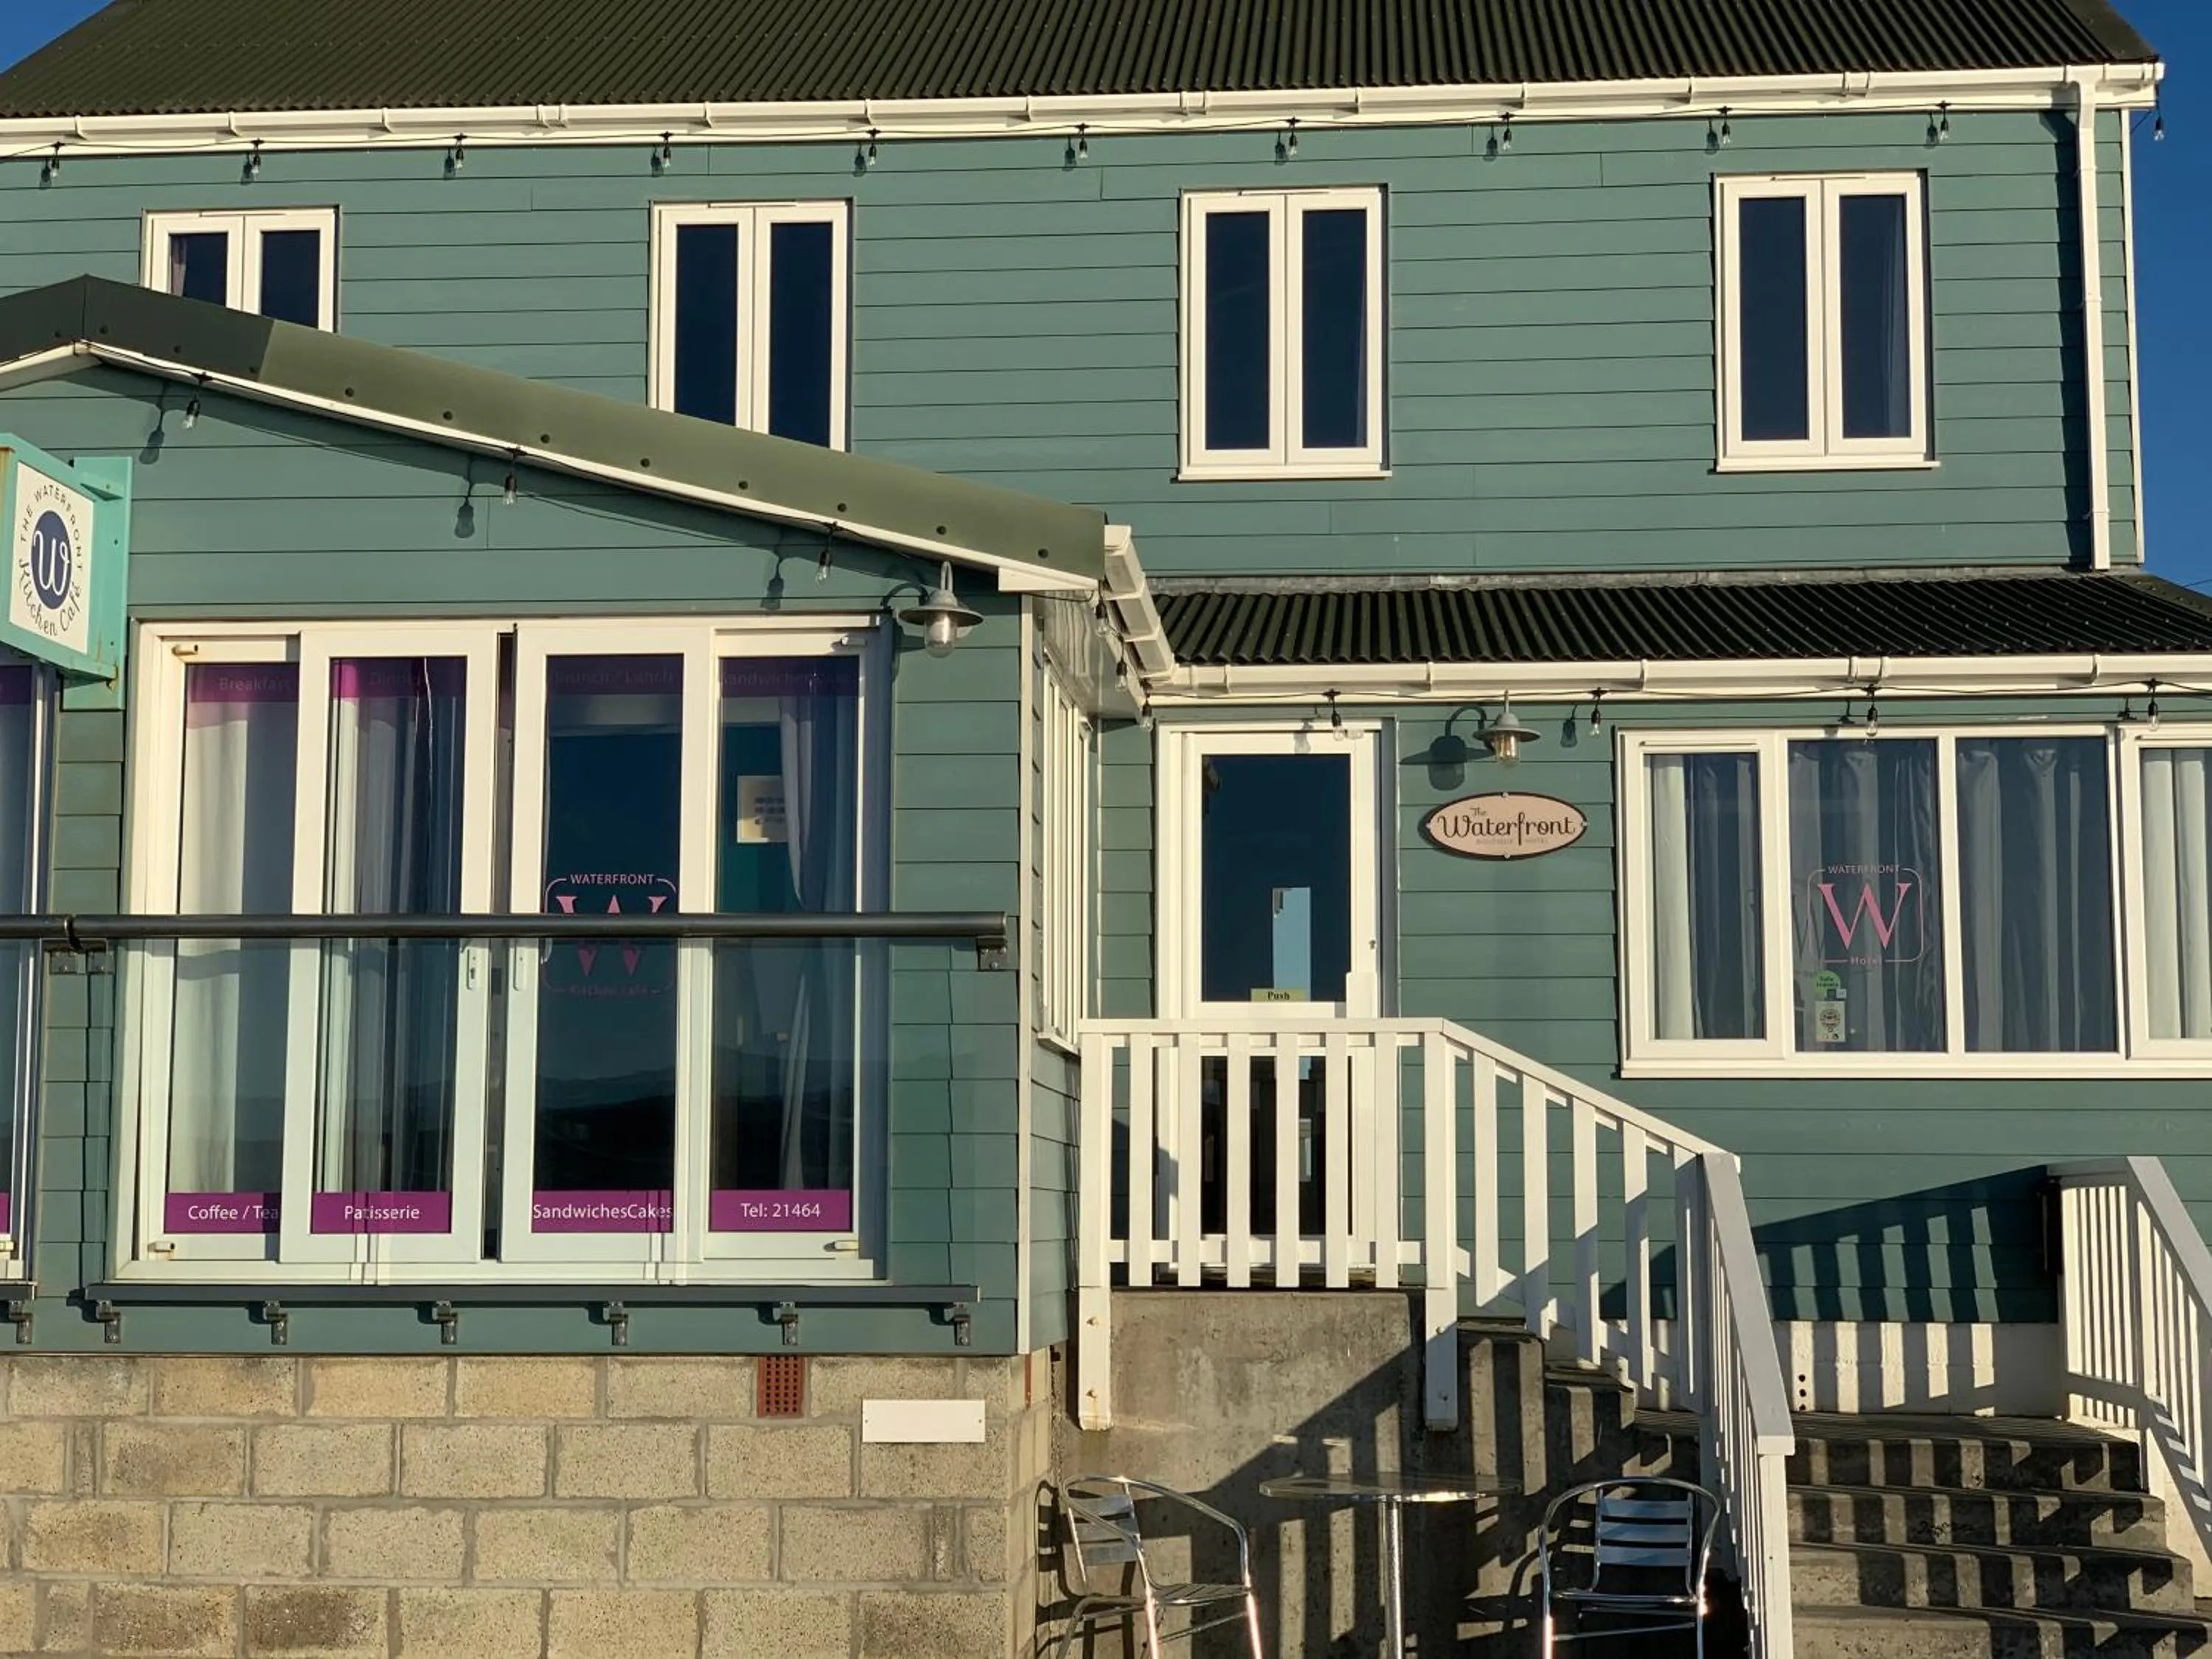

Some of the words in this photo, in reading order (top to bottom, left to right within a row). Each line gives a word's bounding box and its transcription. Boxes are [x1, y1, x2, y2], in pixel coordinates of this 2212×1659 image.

[21, 505, 34, 543] THE
[34, 484, 83, 572] WATERFRONT
[19, 558, 58, 636] Kitchen
[1437, 812, 1576, 846] Waterfront
[570, 873, 655, 885] WATERFRONT
[1817, 883, 1913, 951] W
[1267, 991, 1290, 1001] Push
[187, 1205, 238, 1220] Coffee
[252, 1205, 279, 1220] Tea
[344, 1205, 420, 1220] Patisserie
[740, 1203, 768, 1218] Tel:
[772, 1203, 821, 1218] 21464
